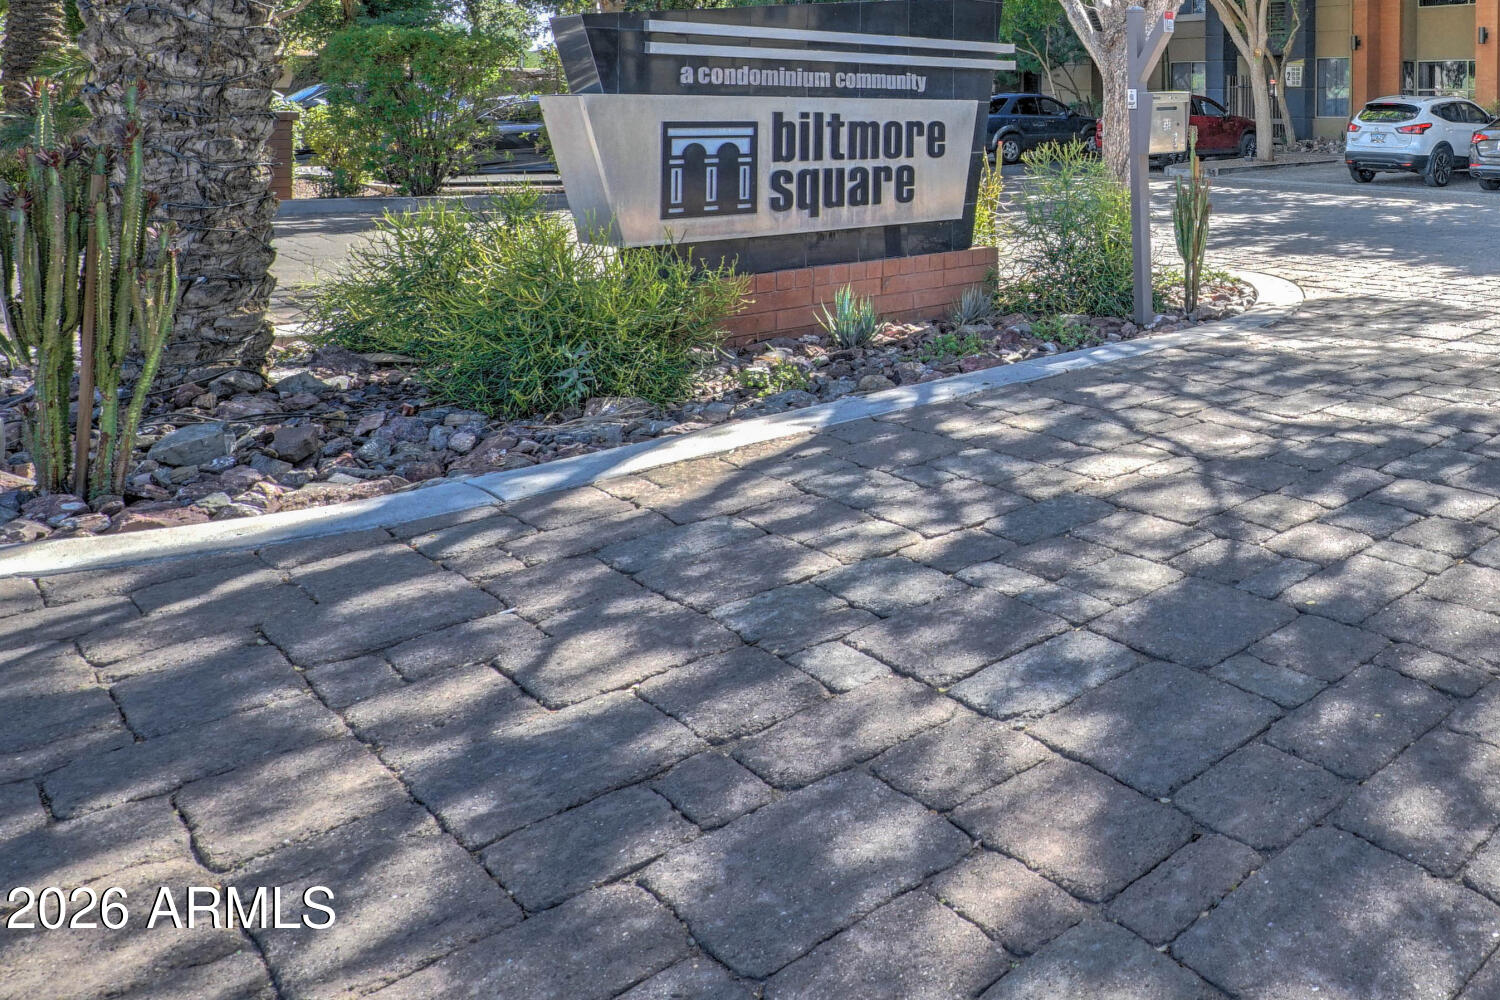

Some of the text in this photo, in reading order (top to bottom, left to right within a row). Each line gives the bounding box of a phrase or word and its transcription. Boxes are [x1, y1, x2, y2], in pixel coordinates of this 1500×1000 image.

[680, 66, 927, 93] a condominium community
[771, 111, 946, 163] biltmore
[769, 164, 916, 218] square
